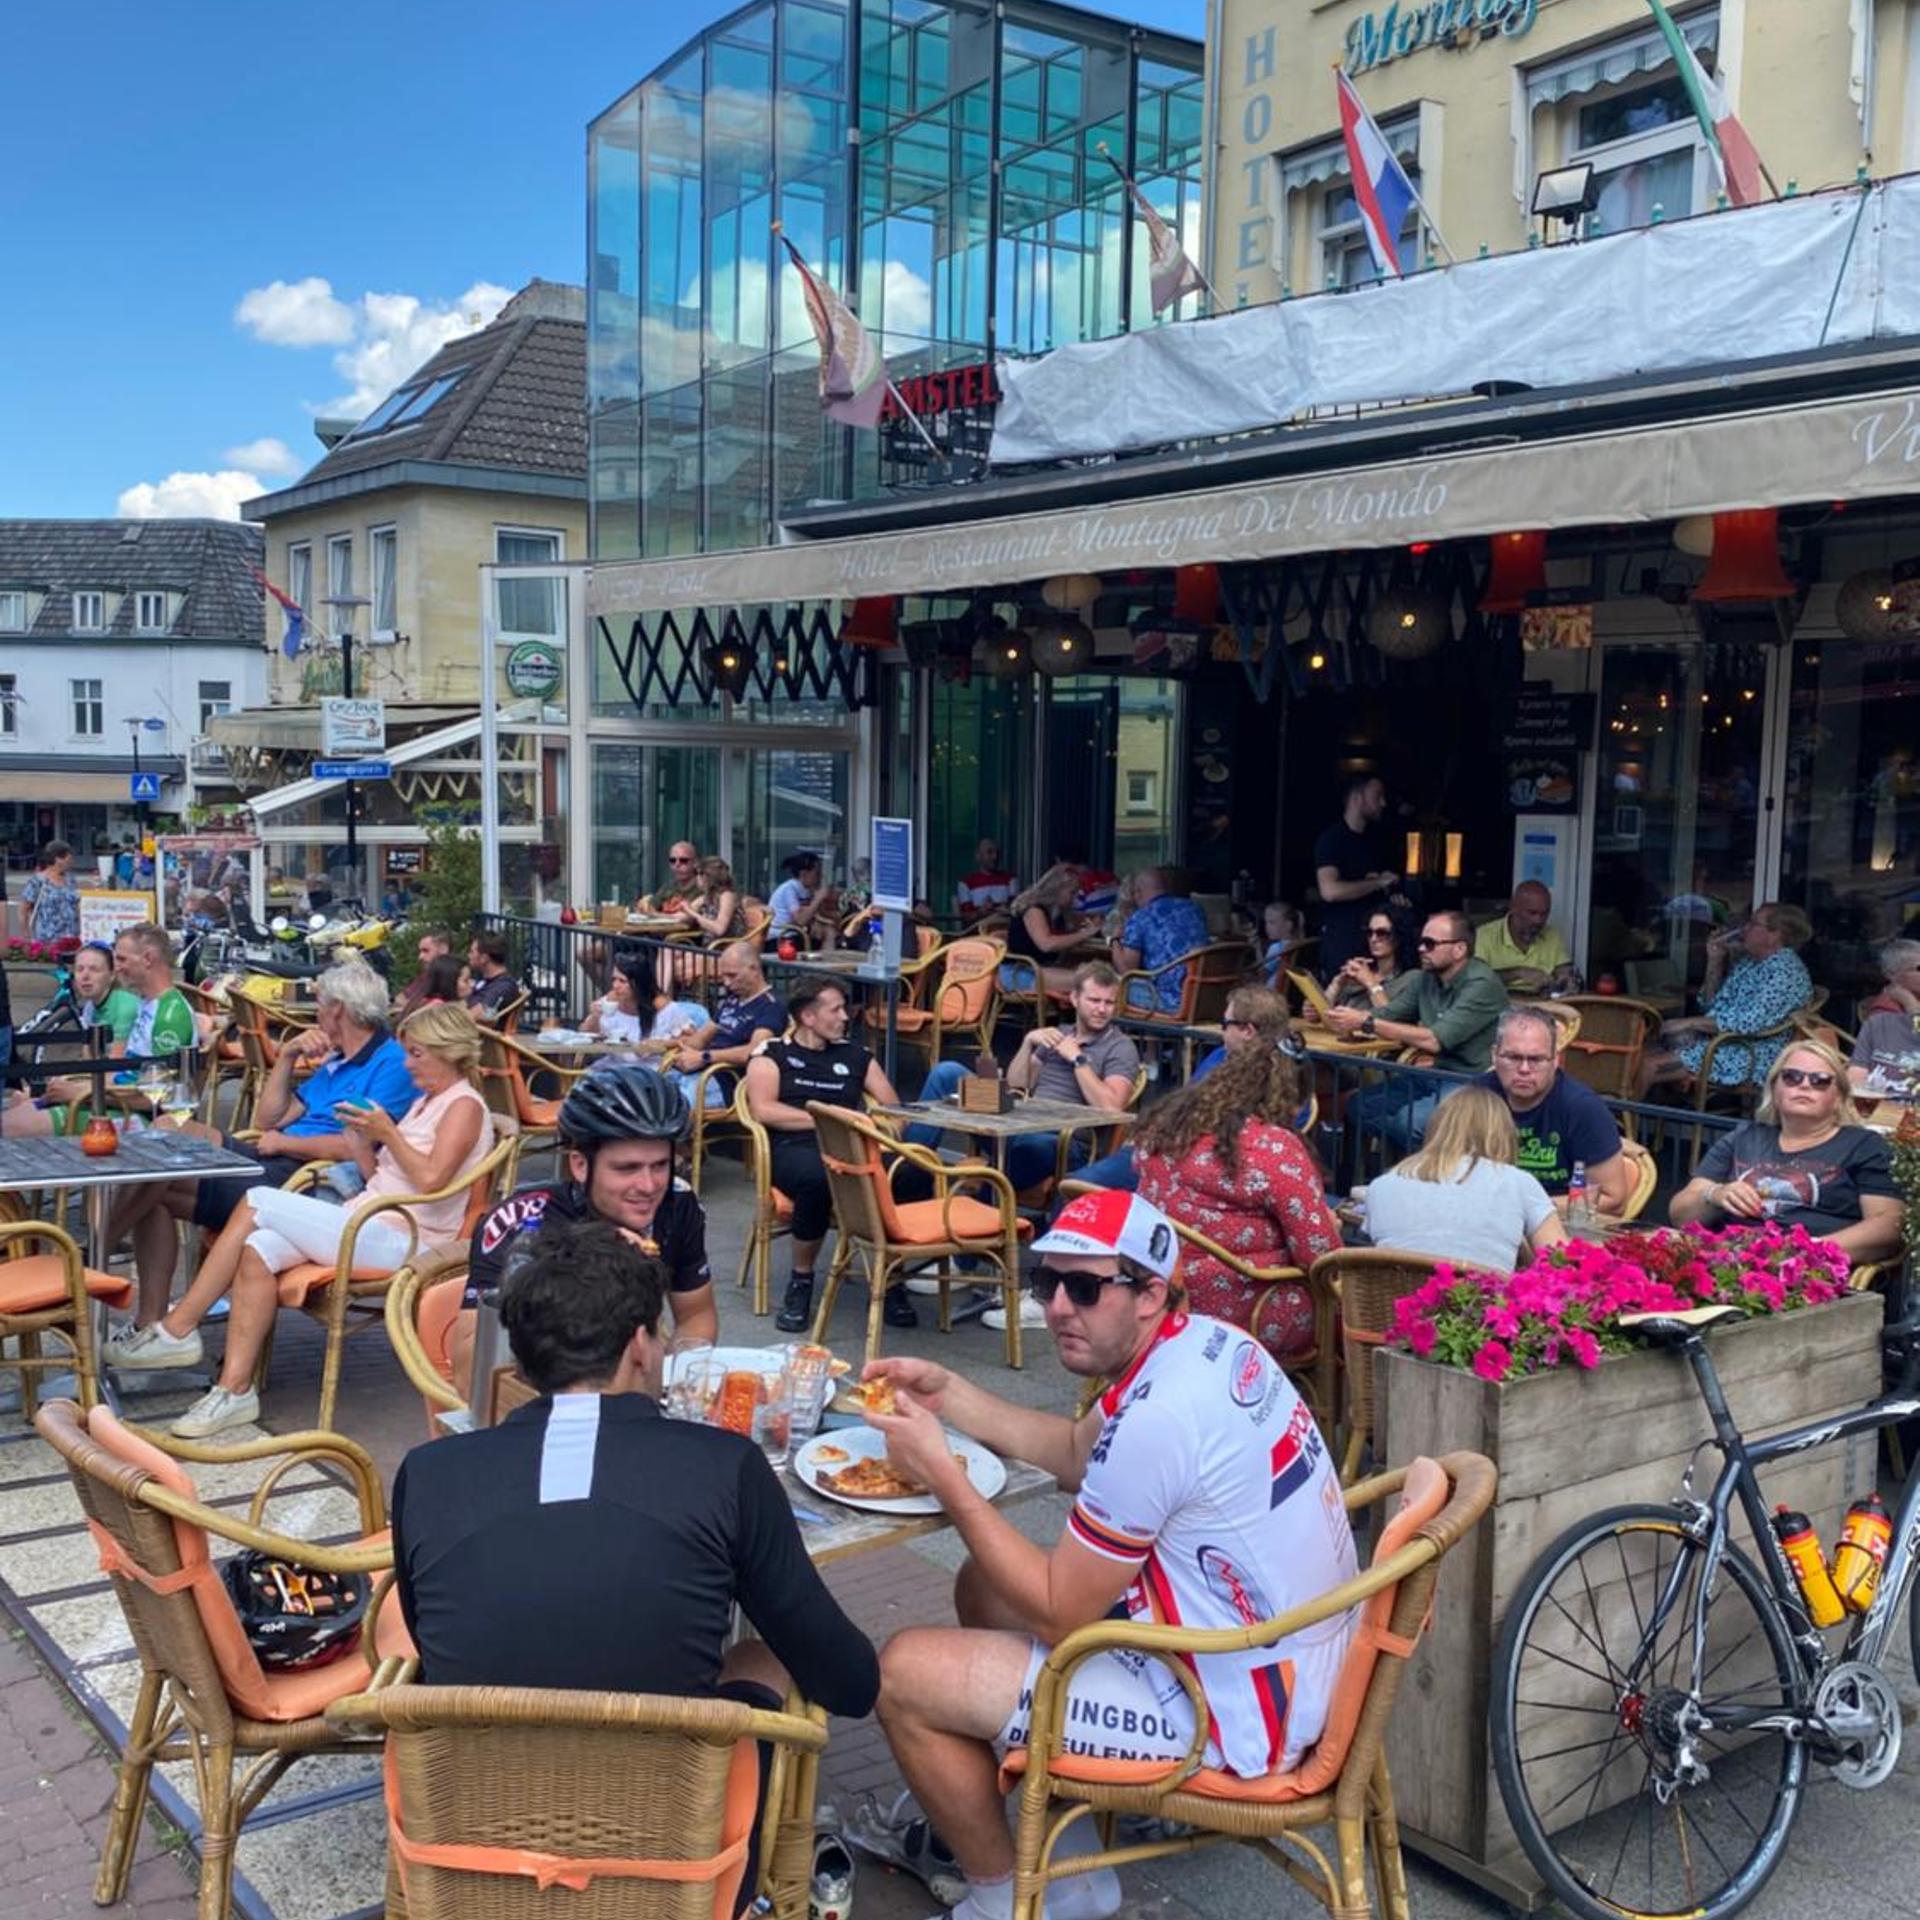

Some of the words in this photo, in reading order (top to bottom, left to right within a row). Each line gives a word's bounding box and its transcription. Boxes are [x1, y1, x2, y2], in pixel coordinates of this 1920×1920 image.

[1237, 25, 1276, 298] HOTE
[1062, 512, 1225, 558] Montagna
[1235, 486, 1304, 537] Del
[1305, 465, 1447, 531] Mondo
